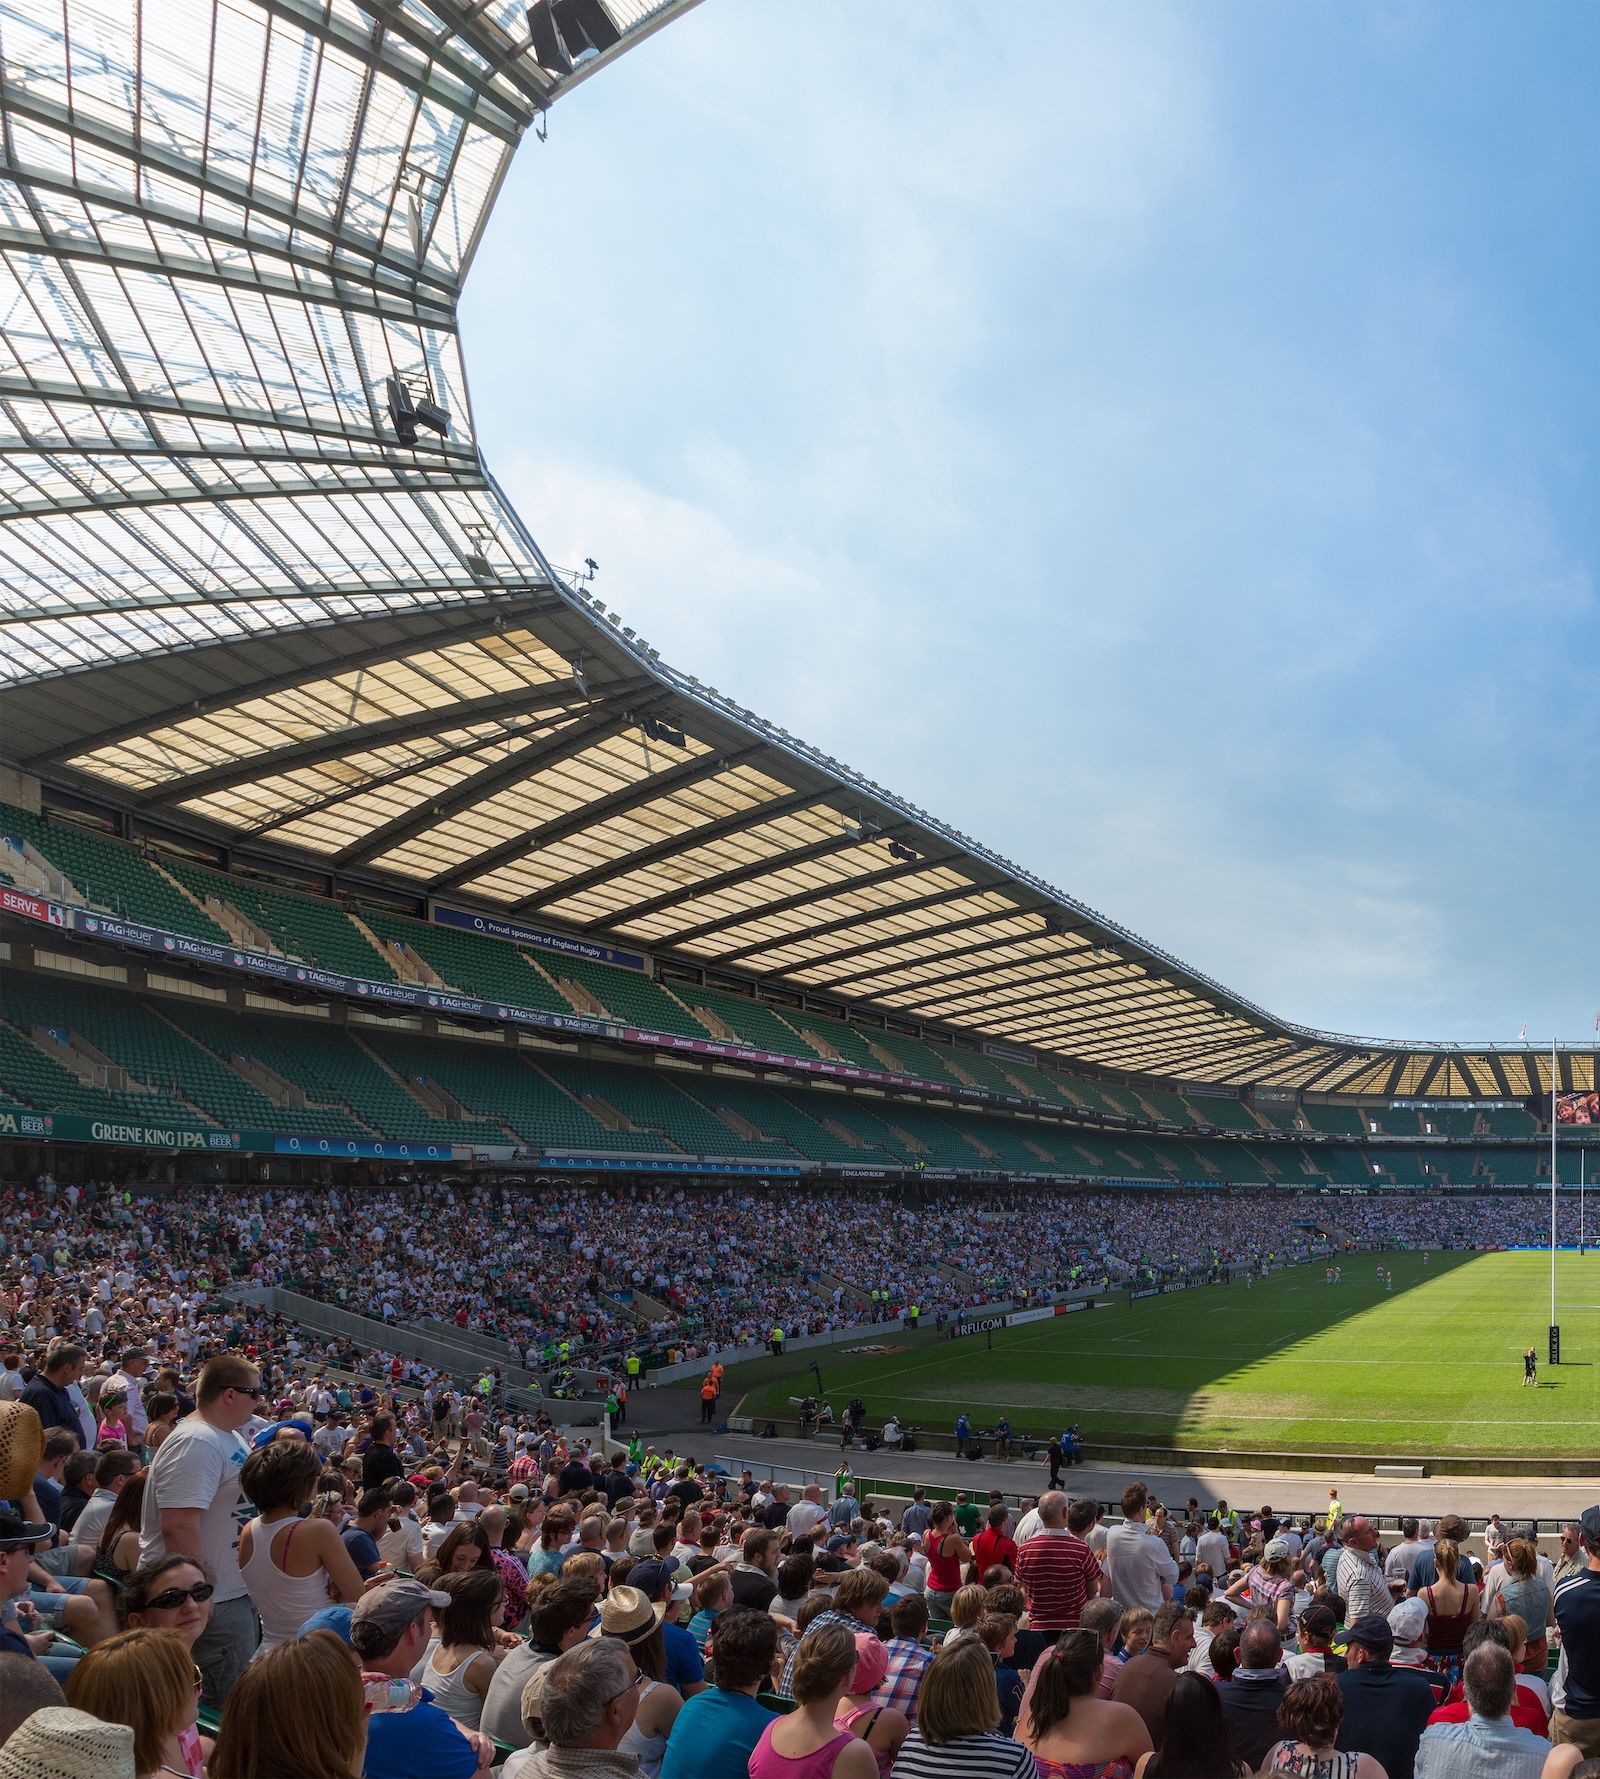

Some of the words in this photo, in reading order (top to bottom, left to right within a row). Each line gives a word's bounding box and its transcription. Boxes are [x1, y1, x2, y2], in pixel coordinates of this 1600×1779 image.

[3, 893, 42, 916] SERVE.
[488, 922, 510, 936] Proud
[511, 930, 542, 943] sponsors
[543, 936, 551, 945] of
[552, 938, 579, 953] England
[580, 945, 601, 958] Rugby
[20, 1115, 43, 1124] OFFICIAL
[20, 1121, 44, 1132] BEER
[91, 1121, 143, 1144] GREENE
[144, 1128, 175, 1146] KING
[176, 1131, 208, 1148] IPA
[209, 1138, 232, 1147] BEER
[961, 1317, 1003, 1335] RFU.COM
